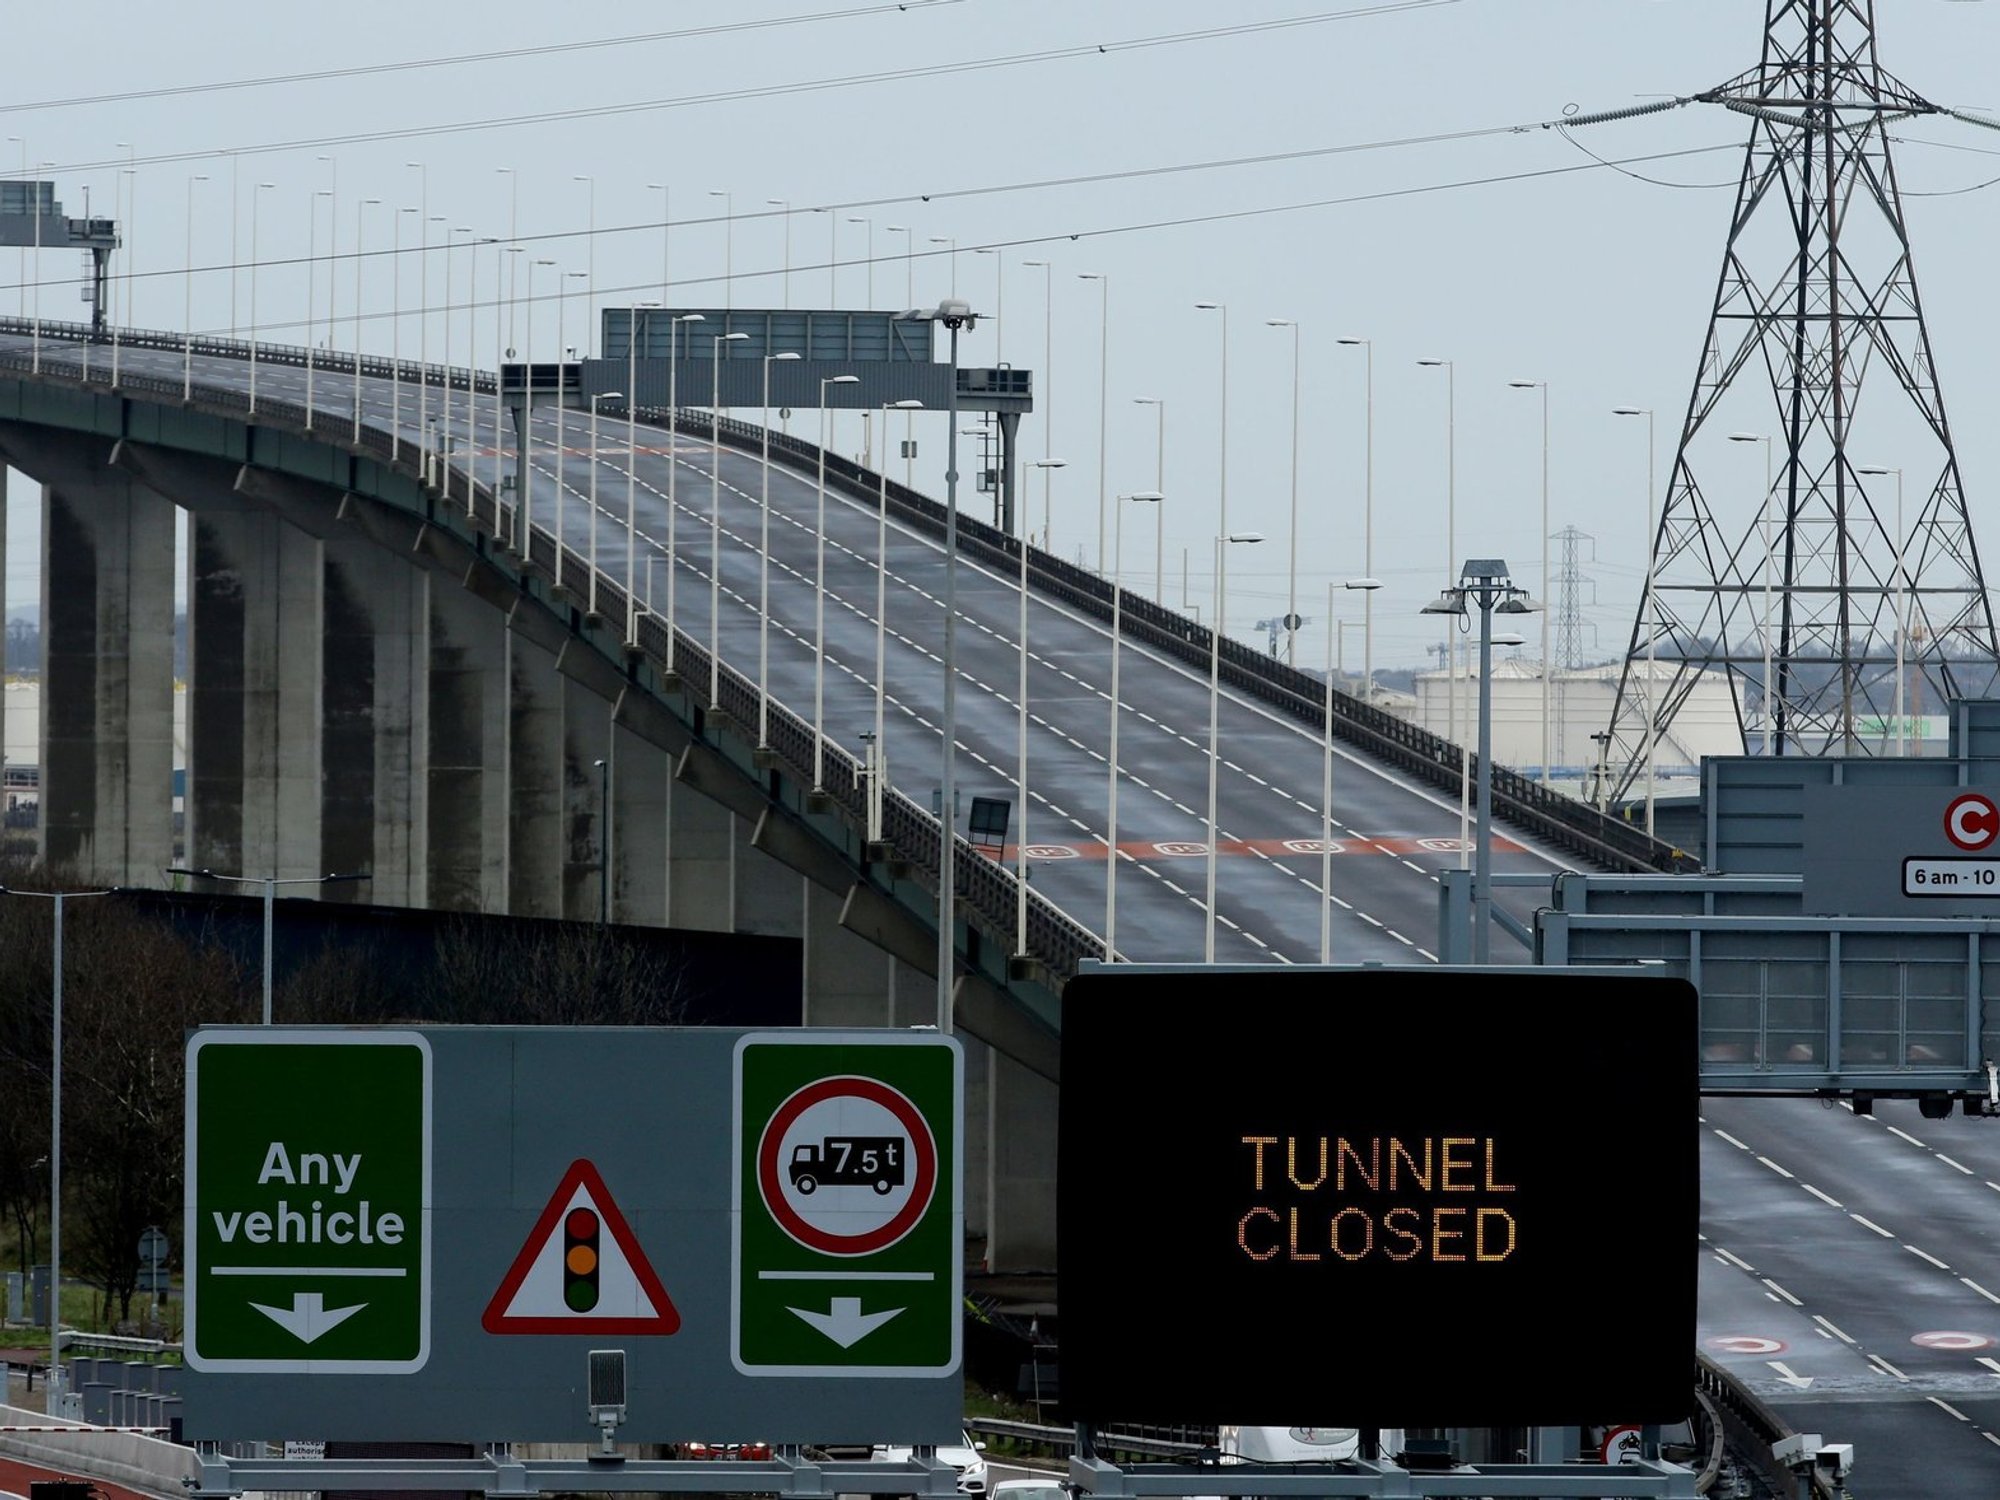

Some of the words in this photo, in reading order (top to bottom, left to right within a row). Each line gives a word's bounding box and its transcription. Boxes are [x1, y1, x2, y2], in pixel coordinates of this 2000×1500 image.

[1951, 801, 1990, 844] C
[1931, 873, 1958, 885] am
[1973, 869, 1995, 885] 10
[257, 1142, 362, 1194] Any
[1241, 1136, 1516, 1192] TUNNEL
[212, 1200, 405, 1245] vehicle
[1238, 1206, 1516, 1262] CLOSED
